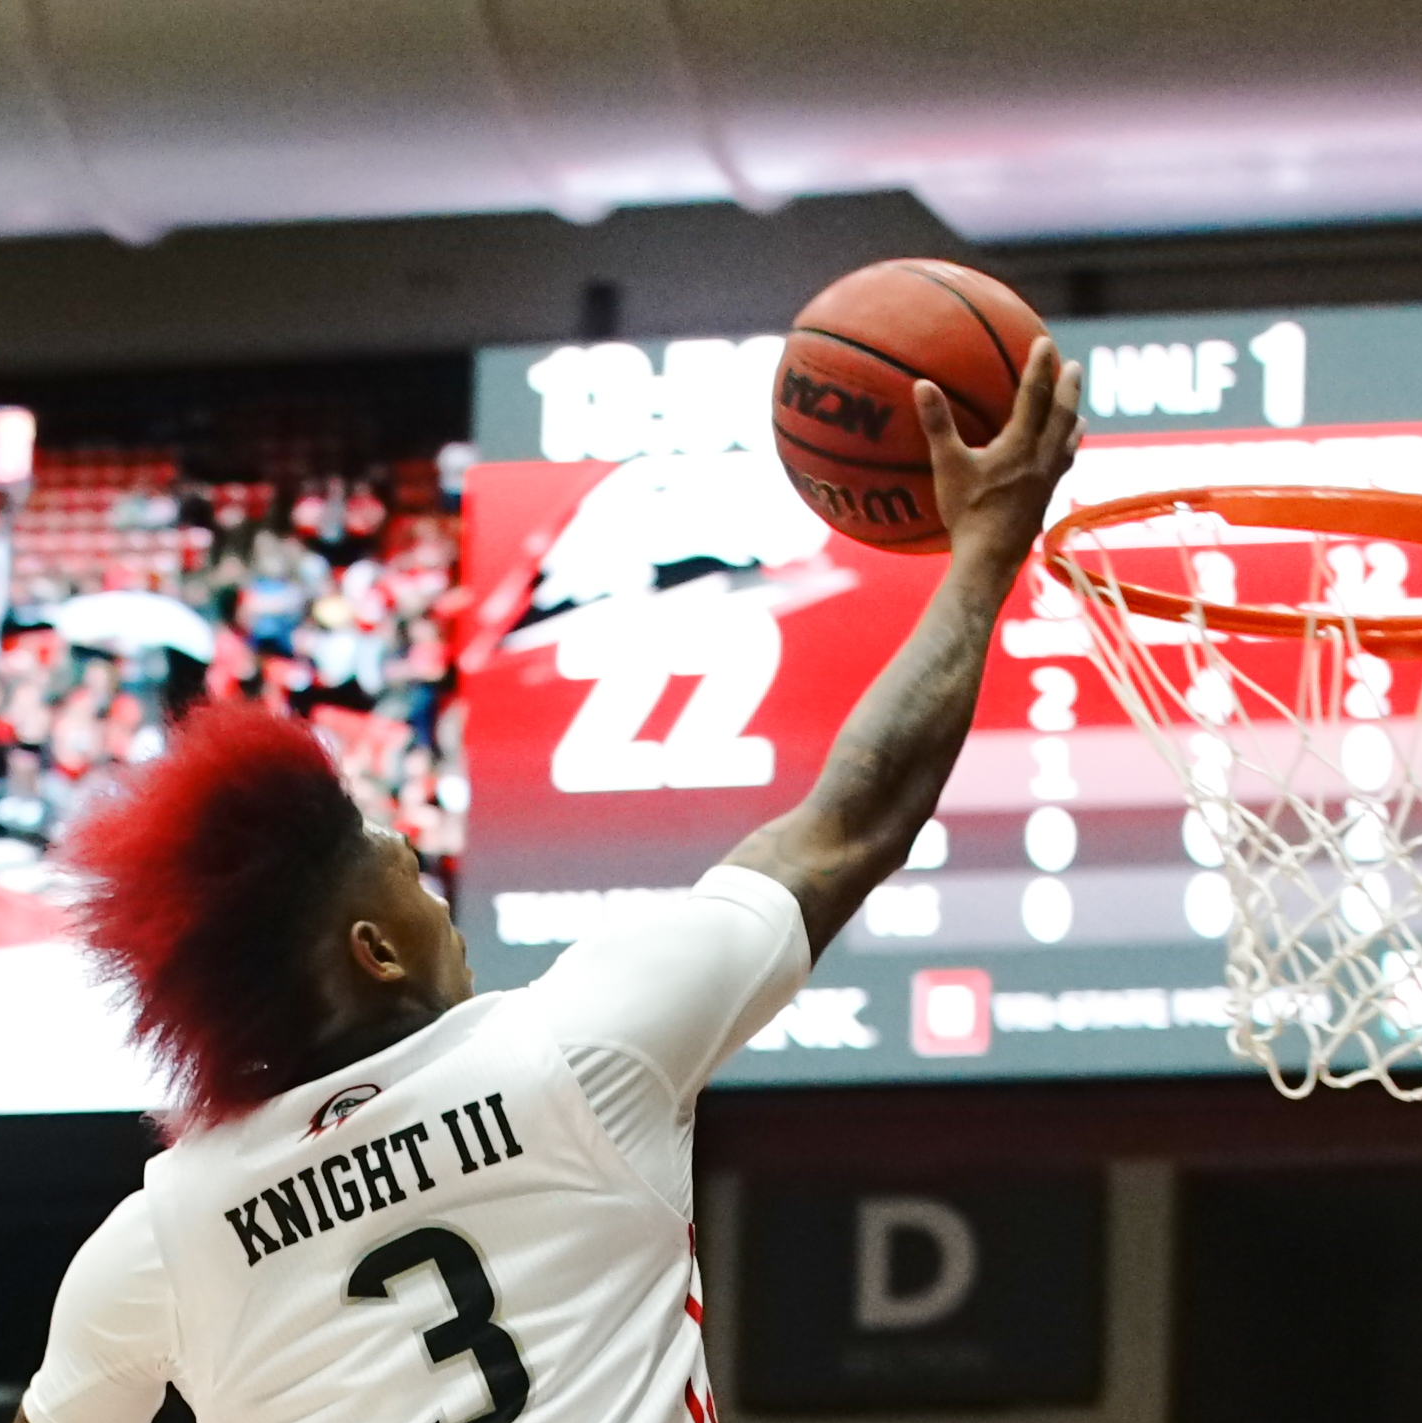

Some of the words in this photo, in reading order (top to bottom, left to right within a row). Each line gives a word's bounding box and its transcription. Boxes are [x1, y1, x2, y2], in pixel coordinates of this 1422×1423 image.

[1249, 320, 1306, 429] 1
[550, 598, 782, 794] 22
[224, 1121, 436, 1268] KNIGHT
[441, 1091, 524, 1175] III
[854, 1195, 981, 1334] D
